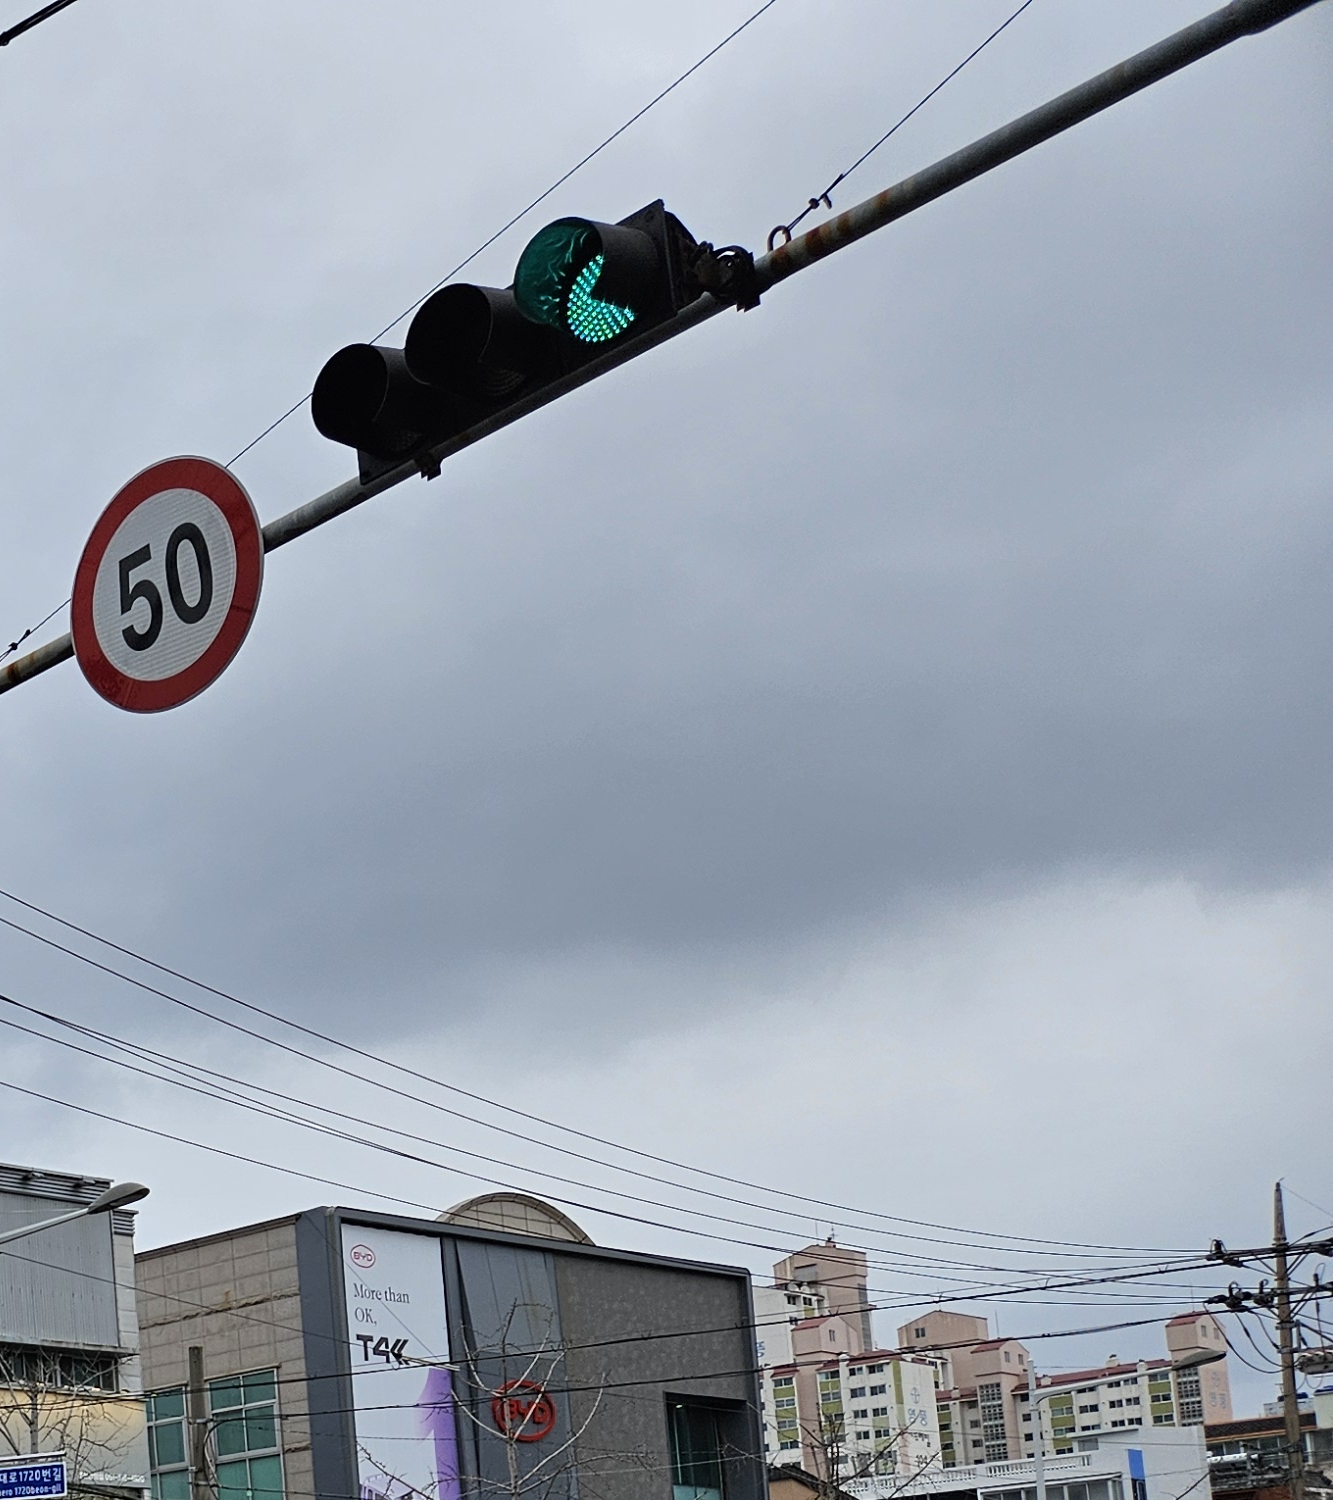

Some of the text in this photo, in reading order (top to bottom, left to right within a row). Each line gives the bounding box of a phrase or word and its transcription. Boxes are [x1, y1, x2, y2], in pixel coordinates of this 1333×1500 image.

[119, 522, 213, 651] 50
[353, 1252, 373, 1262] BYD
[353, 1283, 410, 1304] More than
[354, 1307, 377, 1325] OK,
[14, 1483, 62, 1497] 1720beon-gil
